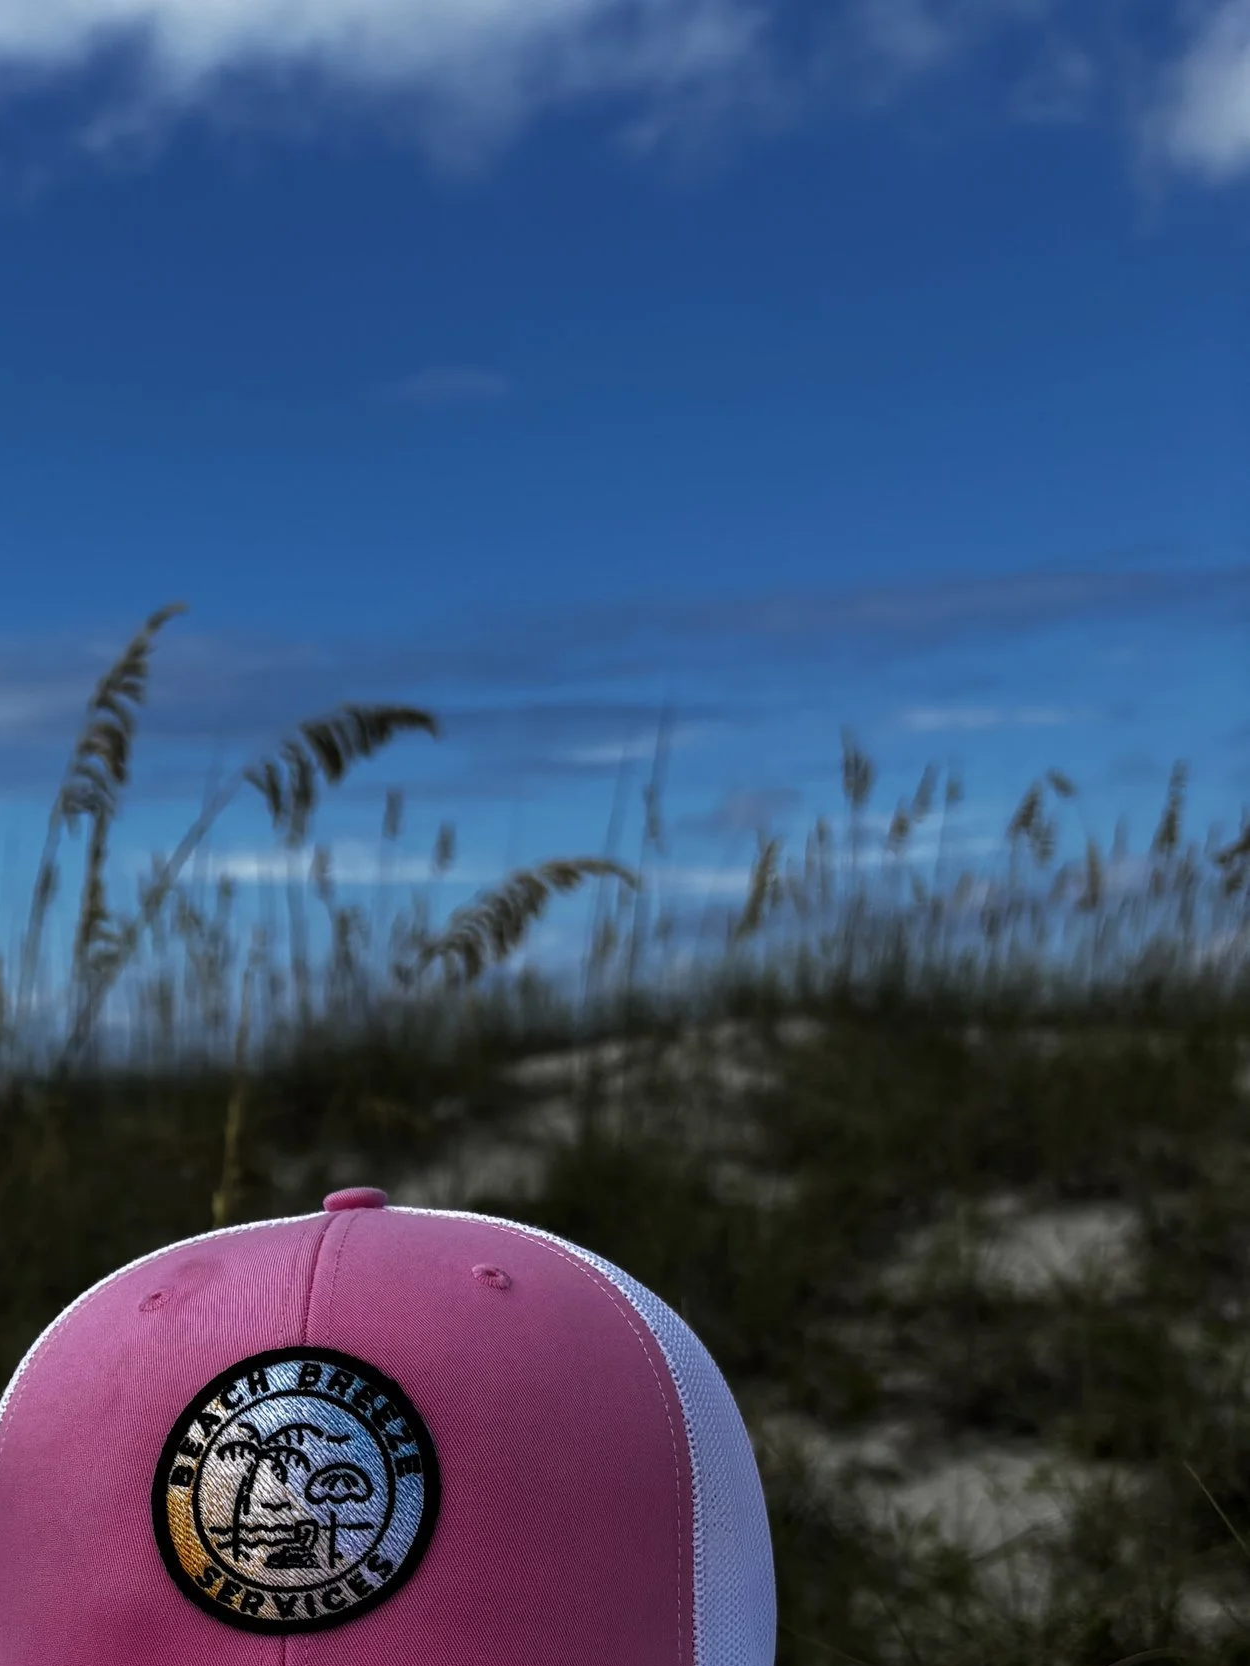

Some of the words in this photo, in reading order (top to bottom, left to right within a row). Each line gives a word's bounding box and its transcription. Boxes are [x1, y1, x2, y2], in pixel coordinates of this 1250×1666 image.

[169, 1367, 270, 1488] BEACH
[299, 1361, 423, 1477] BREEZE
[197, 1554, 396, 1617] SERVICES
